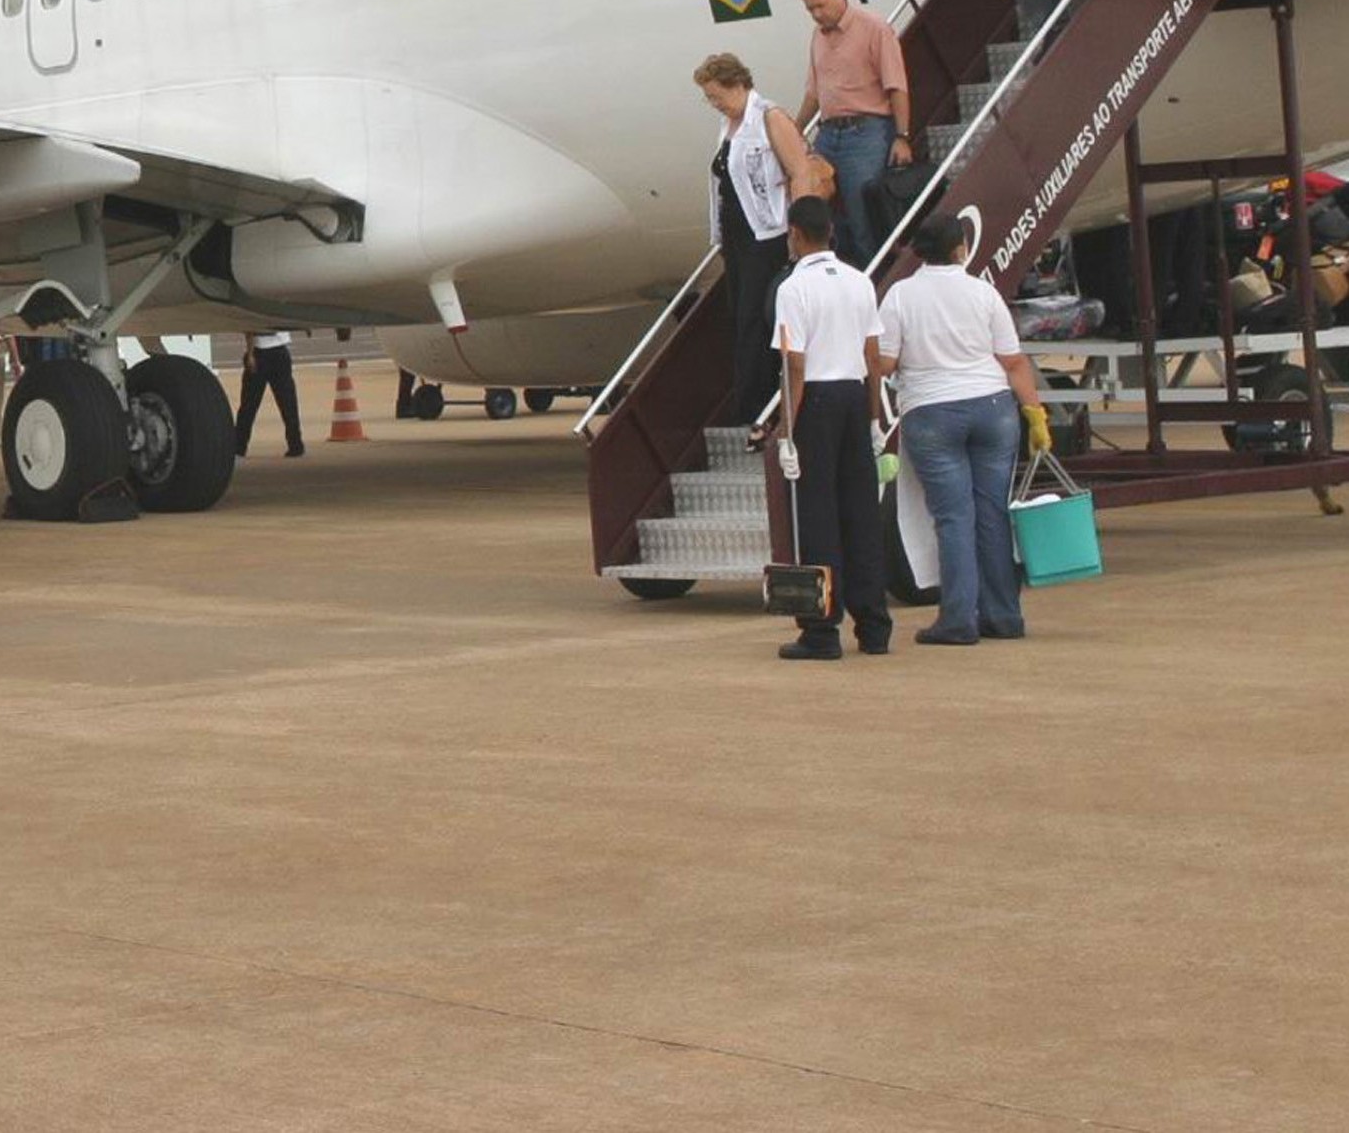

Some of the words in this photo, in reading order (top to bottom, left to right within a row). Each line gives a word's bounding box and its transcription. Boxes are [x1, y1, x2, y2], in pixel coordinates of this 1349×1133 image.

[1034, 124, 1096, 219] AUXILIARES
[1092, 102, 1110, 136] AO
[1106, 10, 1177, 111] TRANSPORTE
